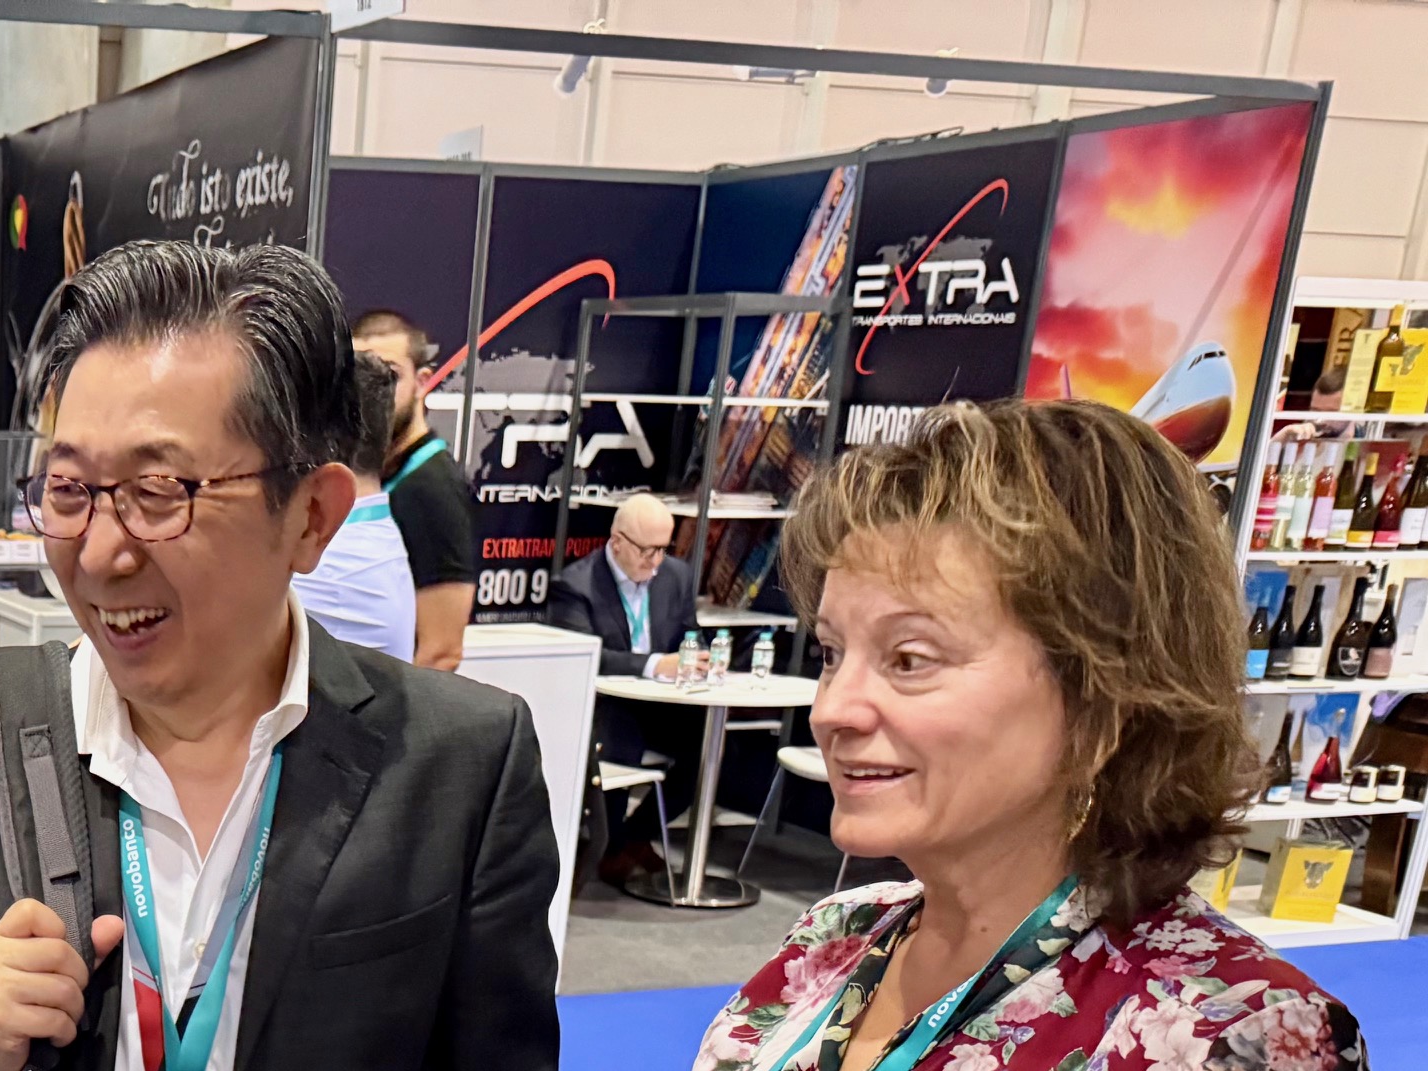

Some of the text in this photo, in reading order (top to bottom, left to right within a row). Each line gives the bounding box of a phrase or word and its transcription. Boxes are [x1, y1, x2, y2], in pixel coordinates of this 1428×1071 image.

[852, 257, 1020, 308] EXTRA
[425, 392, 656, 469] TRA
[477, 568, 549, 606] 800 9
[122, 818, 149, 919] novobanco
